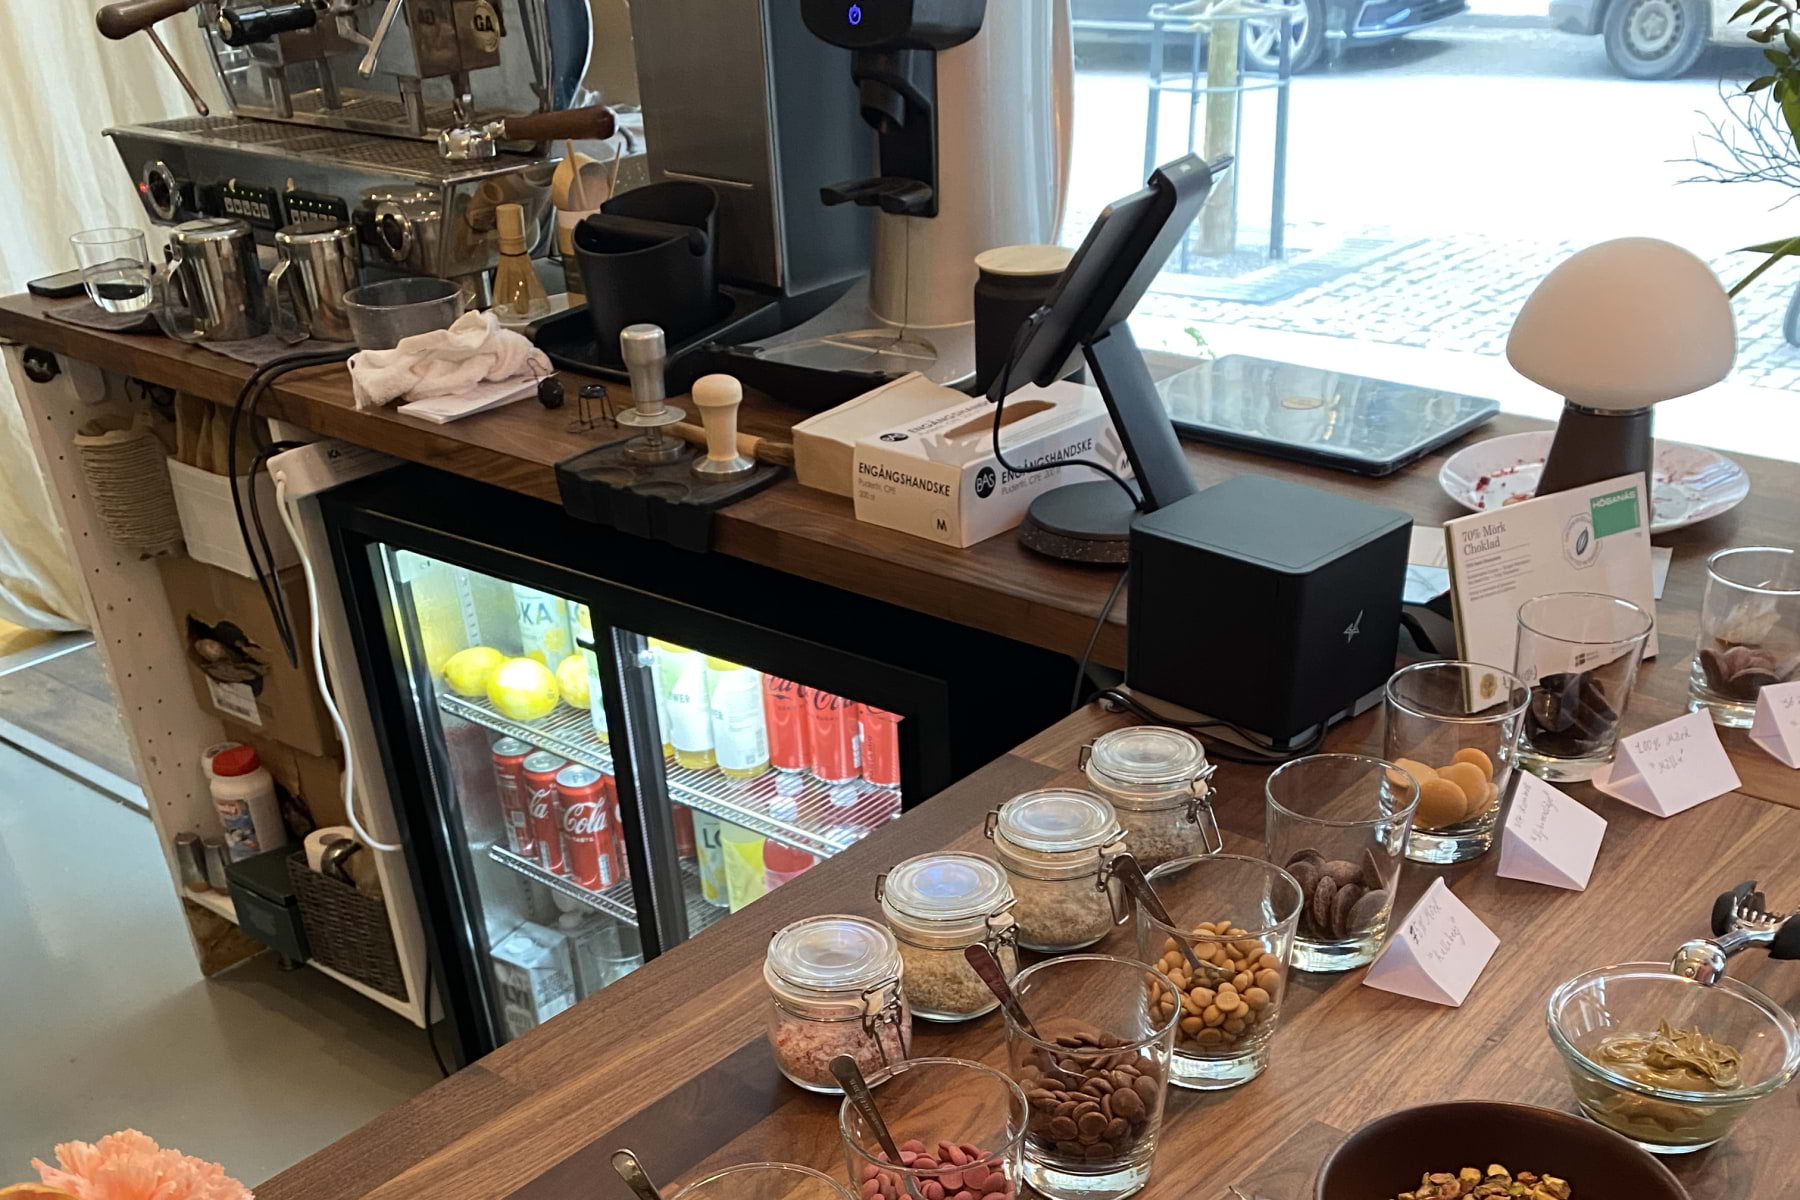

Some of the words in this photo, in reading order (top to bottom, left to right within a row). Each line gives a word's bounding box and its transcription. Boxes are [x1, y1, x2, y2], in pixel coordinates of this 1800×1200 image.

[858, 462, 951, 497] ENGÅNGSHANDSKE
[975, 474, 996, 494] BAS
[936, 518, 948, 532] M
[1462, 529, 1481, 543] 70%
[1482, 522, 1506, 539] Mörk
[1463, 538, 1501, 556] Choklad
[563, 797, 608, 835] Cola
